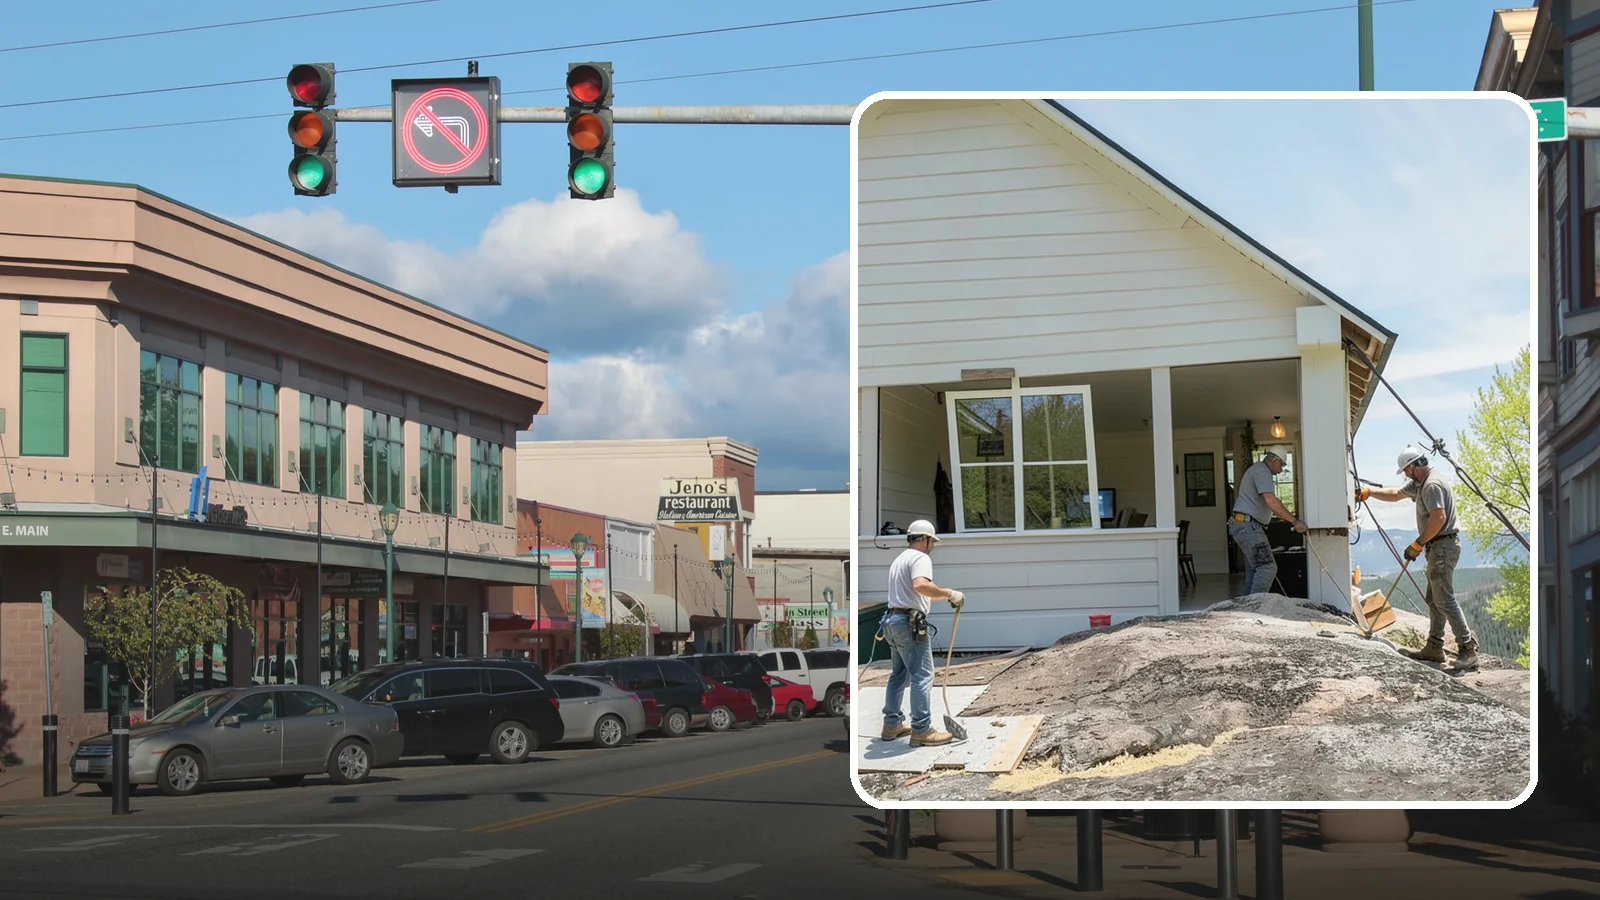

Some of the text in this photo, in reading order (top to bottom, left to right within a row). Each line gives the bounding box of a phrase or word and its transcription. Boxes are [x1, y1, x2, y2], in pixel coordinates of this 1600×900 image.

[670, 480, 728, 494] Jeno's
[665, 496, 731, 509] restaurant
[658, 510, 681, 519] Italian
[686, 509, 715, 519] American
[715, 509, 738, 519] Cuisine
[2, 525, 49, 536] E. MAIN
[785, 607, 795, 617] in
[797, 607, 829, 617] Street
[791, 619, 823, 627] lass
